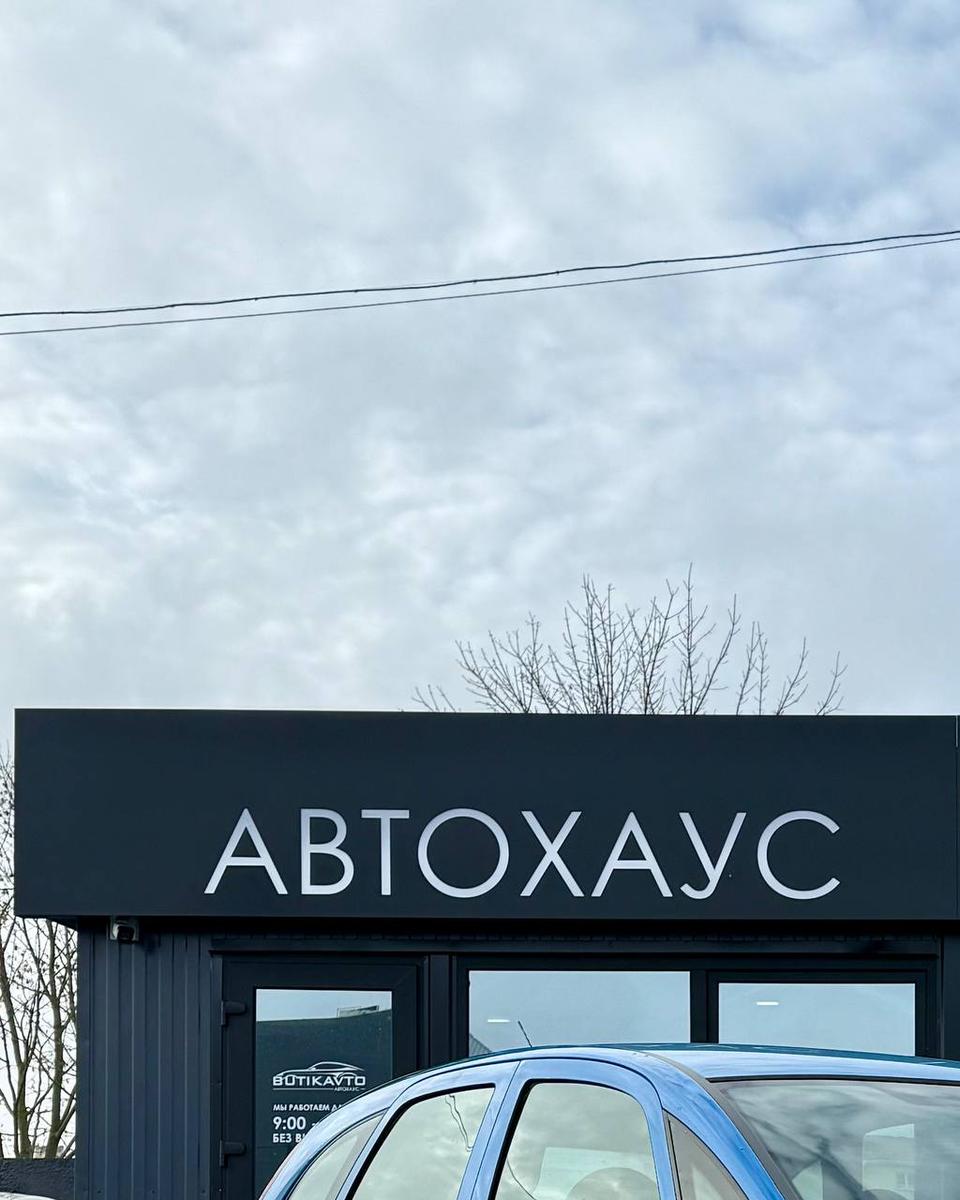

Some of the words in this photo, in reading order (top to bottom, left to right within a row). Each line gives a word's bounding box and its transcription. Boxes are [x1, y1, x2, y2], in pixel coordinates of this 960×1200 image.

[205, 808, 842, 901] АВТОХАУС
[272, 1076, 366, 1086] BUTIKAVTO
[273, 1116, 306, 1130] 9:00
[273, 1134, 291, 1143] БЕЗ
